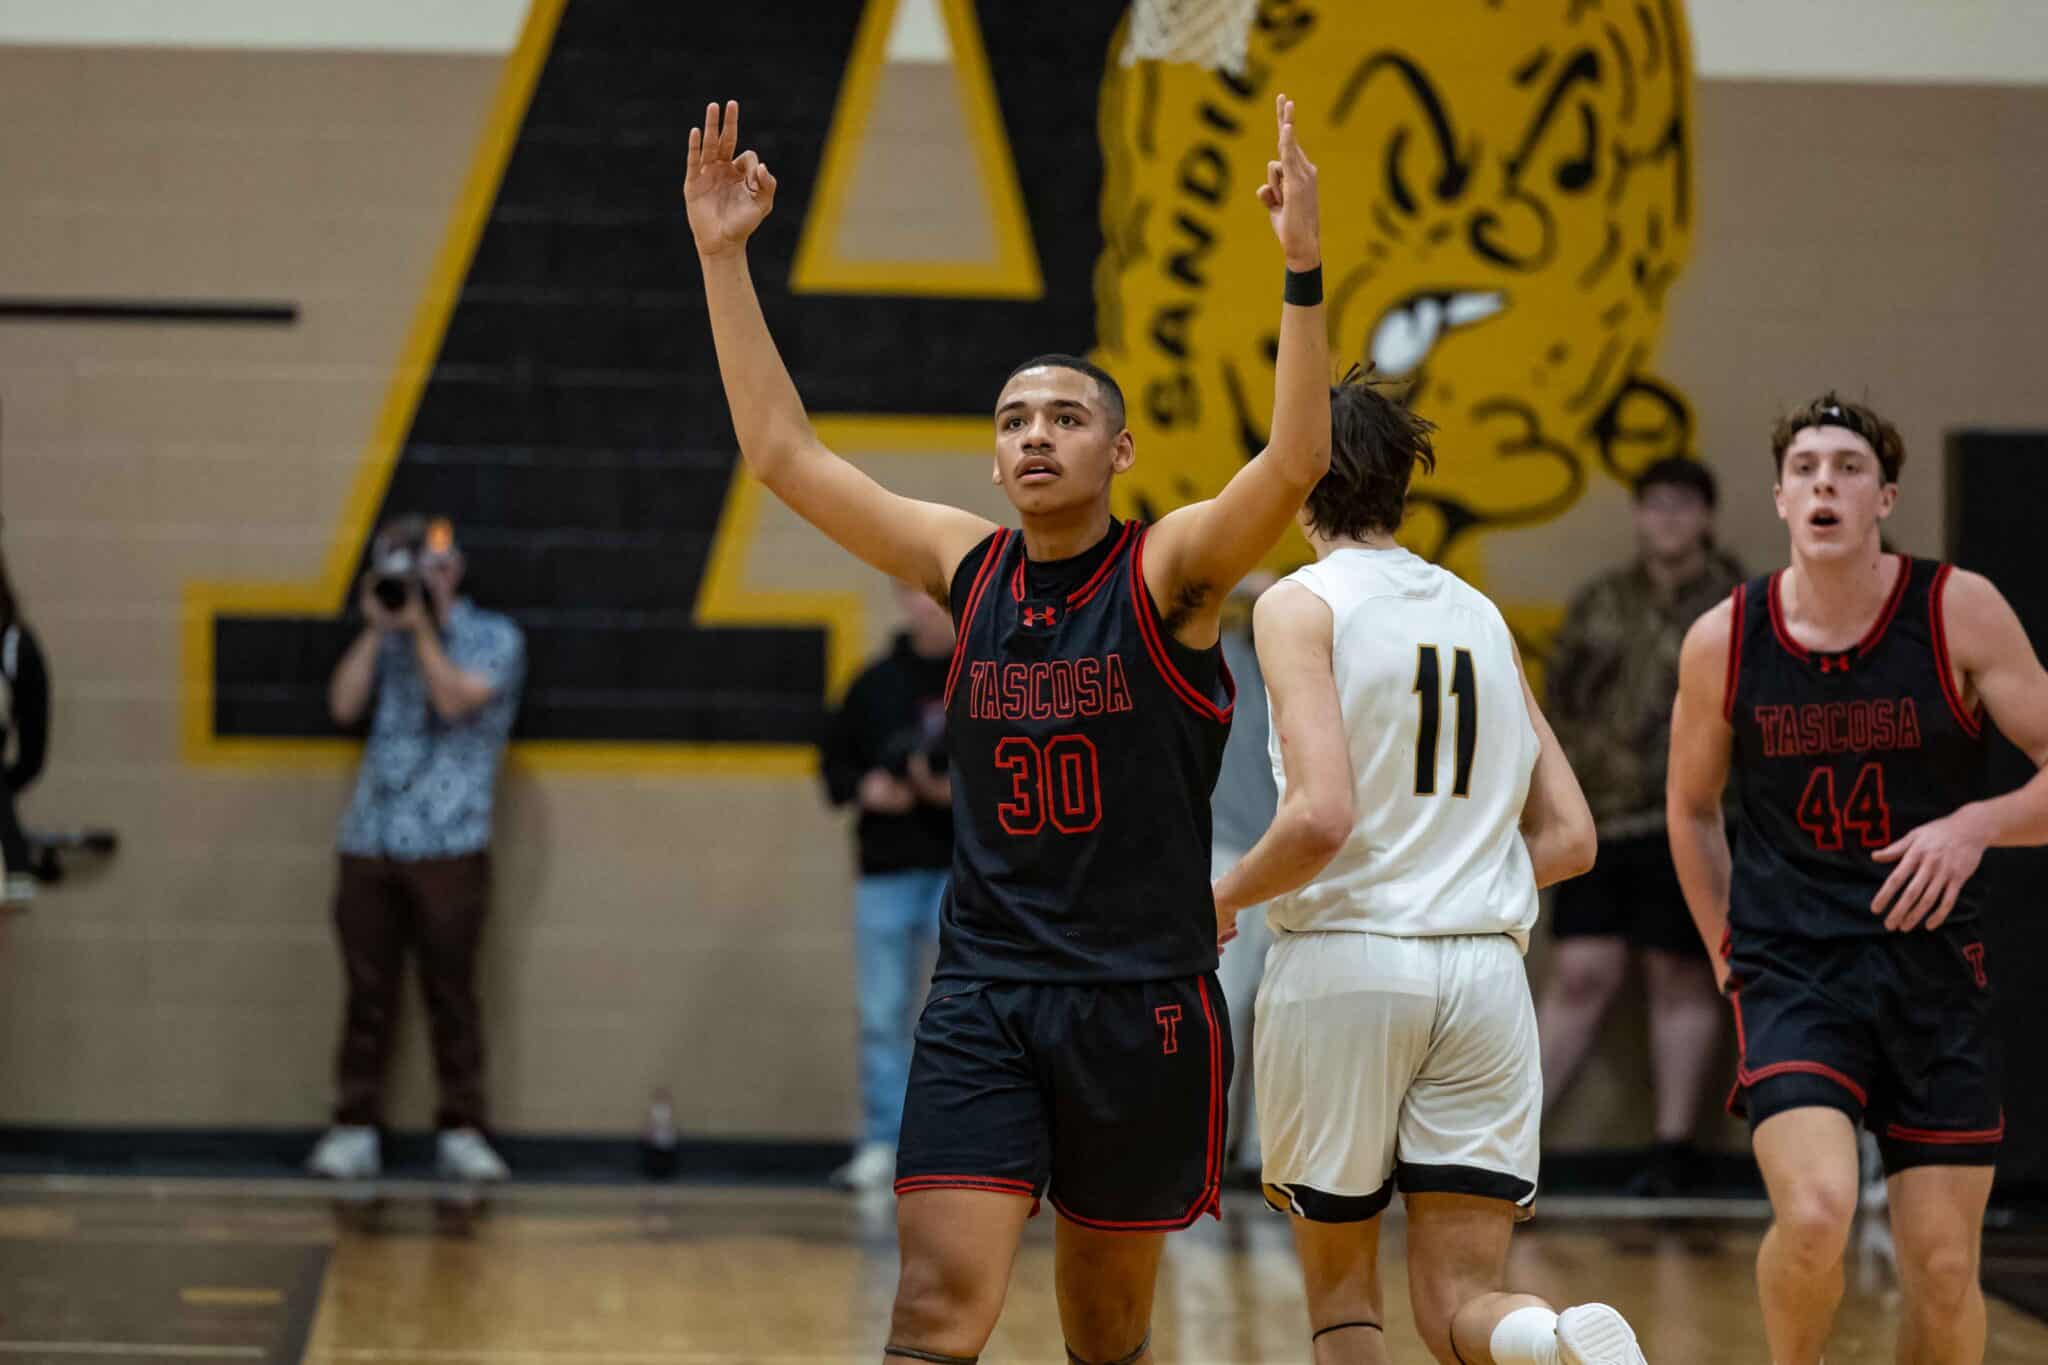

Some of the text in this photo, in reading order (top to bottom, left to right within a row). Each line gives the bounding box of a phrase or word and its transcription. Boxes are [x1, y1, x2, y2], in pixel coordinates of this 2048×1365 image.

[183, 0, 1130, 775] A
[970, 653, 1133, 720] TASCOSA
[1411, 643, 1479, 799] 11
[1756, 698, 1921, 757] TASCOSA
[994, 734, 1102, 836] 30
[1797, 762, 1890, 850] 44
[1155, 1004, 1182, 1055] T
